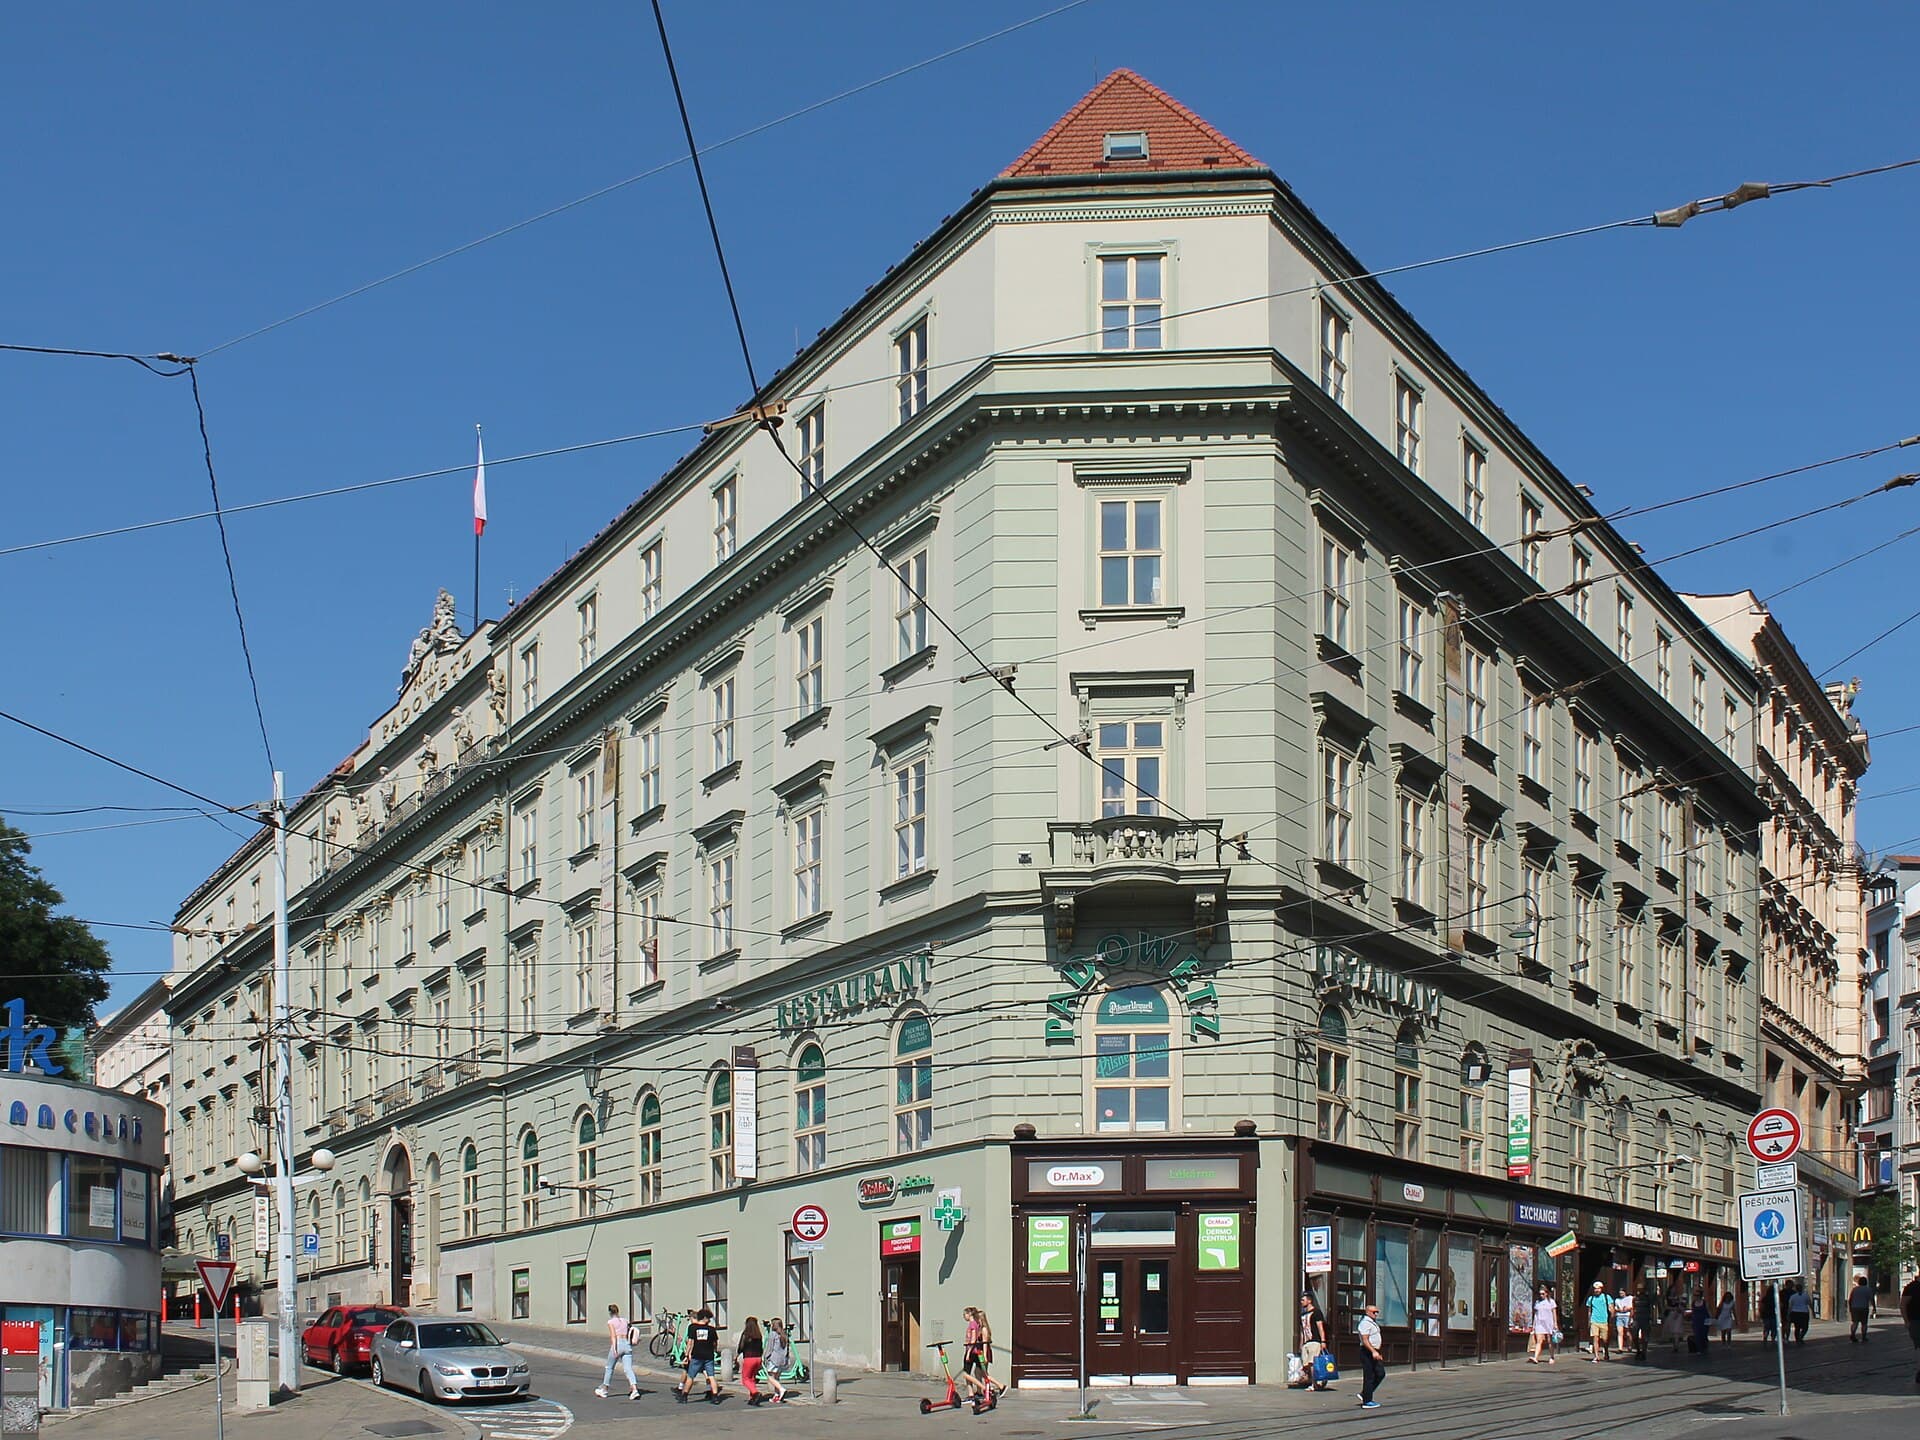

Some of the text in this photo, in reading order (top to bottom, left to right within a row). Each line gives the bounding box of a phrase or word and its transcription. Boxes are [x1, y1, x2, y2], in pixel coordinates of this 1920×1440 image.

[383, 649, 472, 740] PADOWETZ
[777, 953, 928, 1028] RESTAURANT
[1045, 930, 1220, 1042] PADOWETZ
[1316, 944, 1442, 1017] RESTAURANT
[0, 1100, 143, 1143] ANCELÁŘ
[1053, 1171, 1093, 1182] Dr.Max
[1519, 1205, 1557, 1225] EXCHANGE
[1745, 1195, 1790, 1208] PĚŠÍ ZÓNA
[306, 1236, 316, 1248] P
